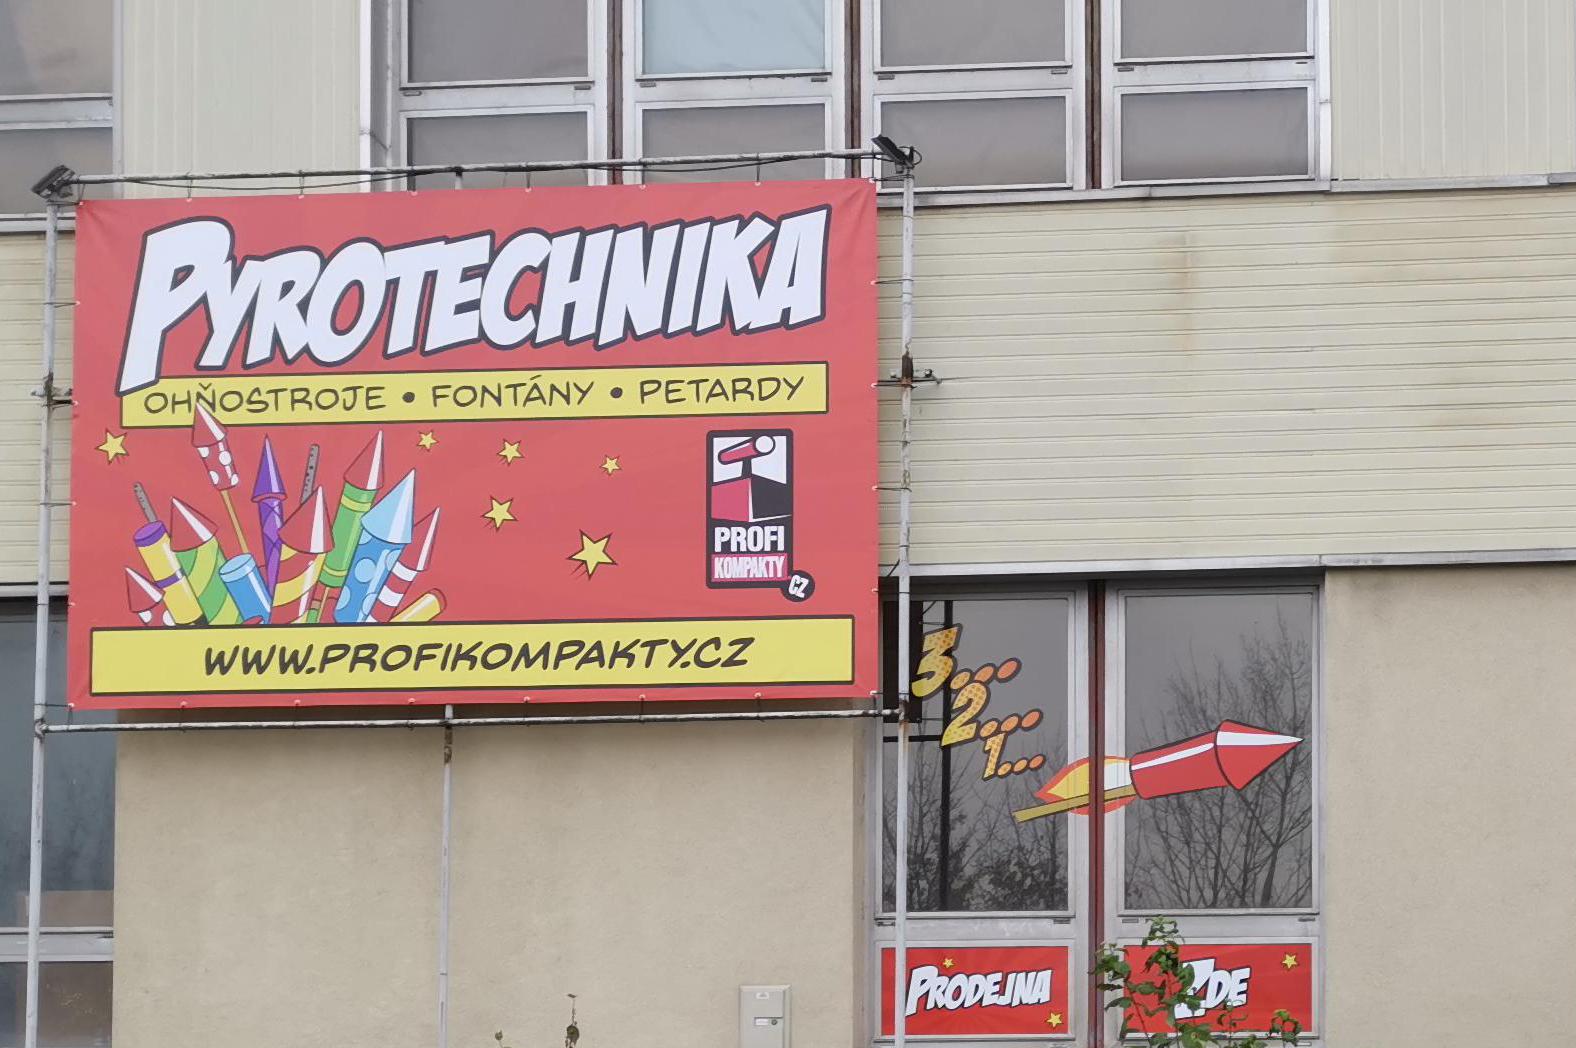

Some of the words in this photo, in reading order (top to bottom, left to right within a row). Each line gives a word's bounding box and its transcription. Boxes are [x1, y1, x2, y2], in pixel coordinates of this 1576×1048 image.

[119, 206, 832, 394] PYROTECHNIKA
[144, 382, 386, 414] OHŇOSTROJE
[432, 374, 594, 408] FONTÁNY
[639, 376, 805, 405] PETARDY
[714, 526, 785, 552] PROFI
[714, 556, 786, 579] KOMPAKTY
[788, 575, 809, 598] CZ
[204, 638, 755, 678] WWW.PROFIKOMPAKTY.CZ
[905, 965, 1053, 1017] PRODEJNA
